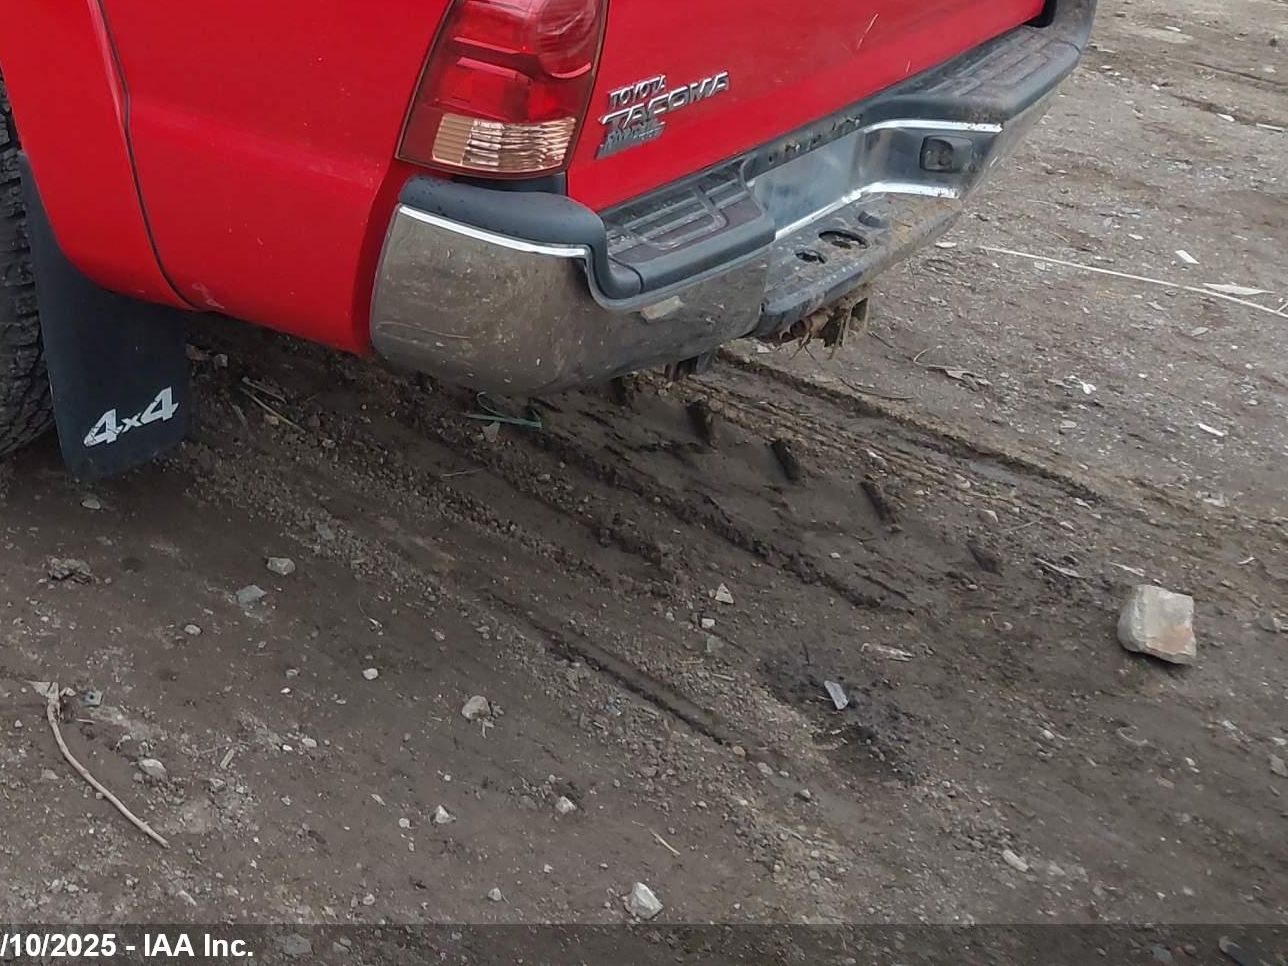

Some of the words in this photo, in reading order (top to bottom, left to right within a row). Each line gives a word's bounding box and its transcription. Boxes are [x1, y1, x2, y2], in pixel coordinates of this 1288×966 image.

[598, 71, 728, 129] TACOMA
[610, 74, 666, 109] TOYOTA
[83, 385, 179, 447] 4x4
